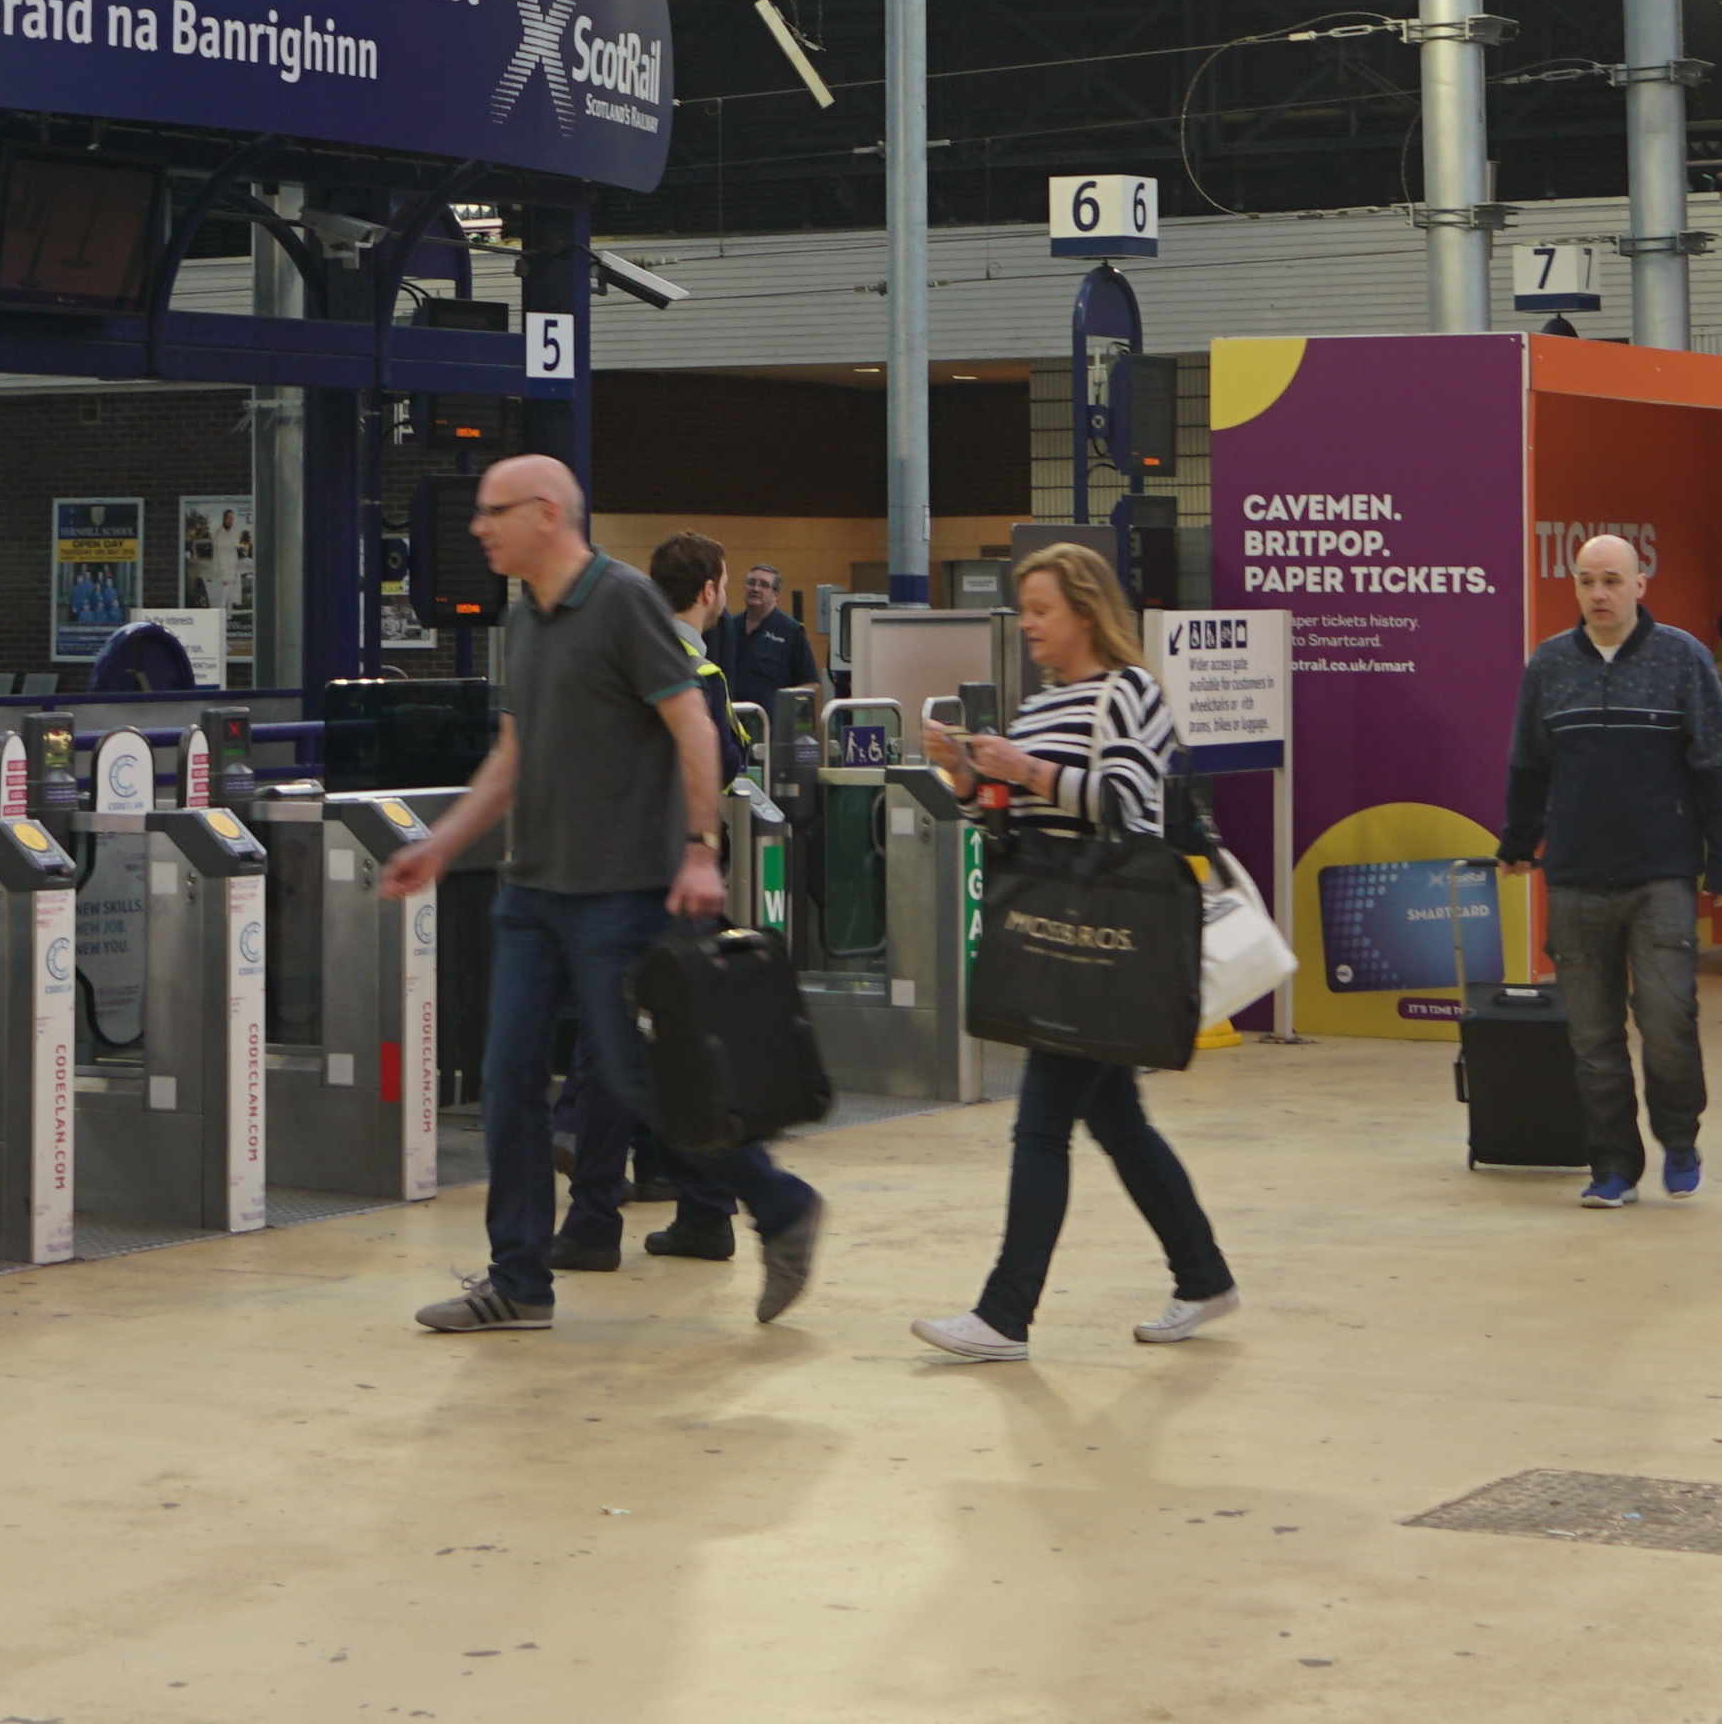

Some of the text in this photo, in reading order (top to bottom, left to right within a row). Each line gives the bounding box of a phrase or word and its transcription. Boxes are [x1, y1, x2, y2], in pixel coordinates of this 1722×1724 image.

[107, 3, 158, 53] na
[572, 15, 661, 105] ScotRail
[1072, 180, 1101, 232] 6
[1132, 182, 1147, 233] 6
[1533, 248, 1556, 289] 7
[1583, 248, 1593, 289] 7
[542, 319, 561, 370] 5
[1243, 494, 1402, 521] CAVEMEN.
[72, 539, 124, 548] OPEN DAY
[1244, 530, 1390, 557] BRITPOP.
[1244, 566, 1496, 594] PAPER TICKETS.
[1308, 634, 1383, 647] Smartcard.
[1322, 614, 1421, 631] tickets history.
[1292, 658, 1415, 674] otrail.co.uk/smart
[248, 1022, 258, 1162] CODECLAN.COM
[54, 1044, 67, 1191] CODECLAN.COM
